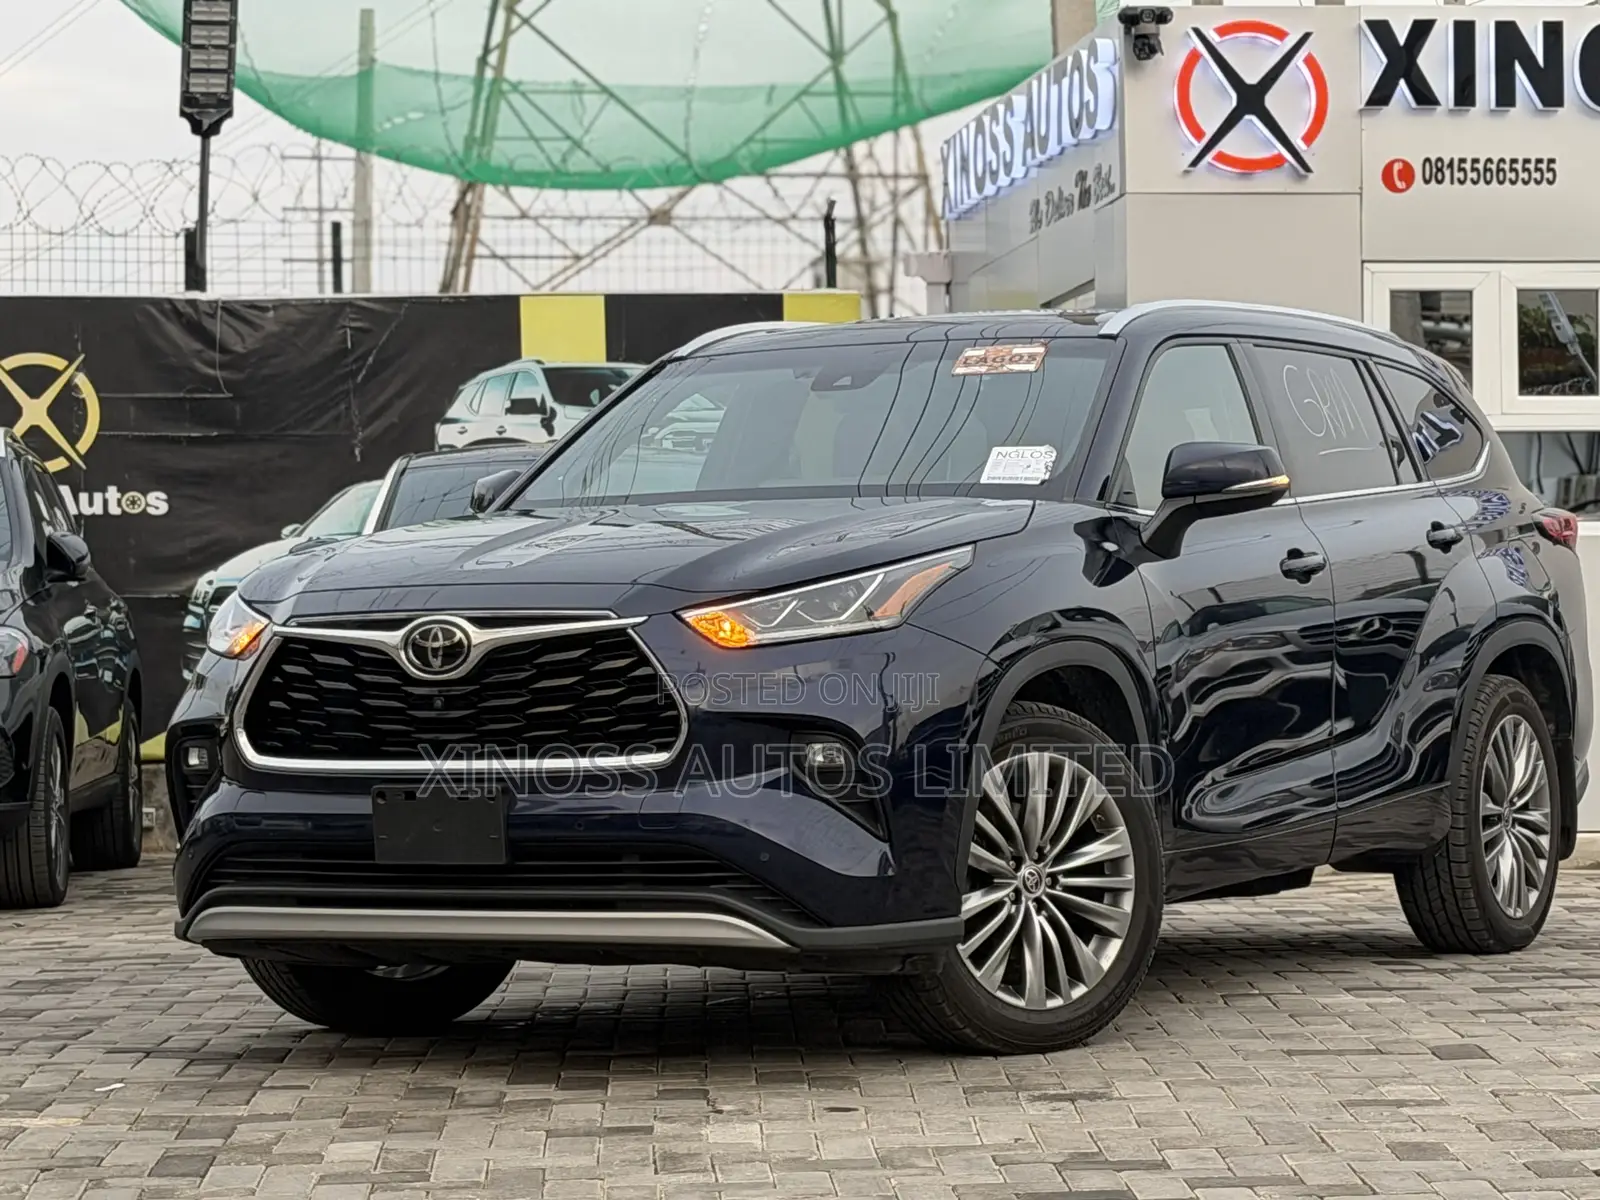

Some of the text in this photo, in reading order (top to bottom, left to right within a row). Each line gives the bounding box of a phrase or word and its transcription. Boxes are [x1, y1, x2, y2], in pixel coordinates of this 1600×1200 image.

[1362, 18, 1600, 112] XIN
[940, 38, 1106, 221] XINOSS AUTOS
[1421, 156, 1557, 186] 08155665555
[996, 450, 1054, 460] NGLOS
